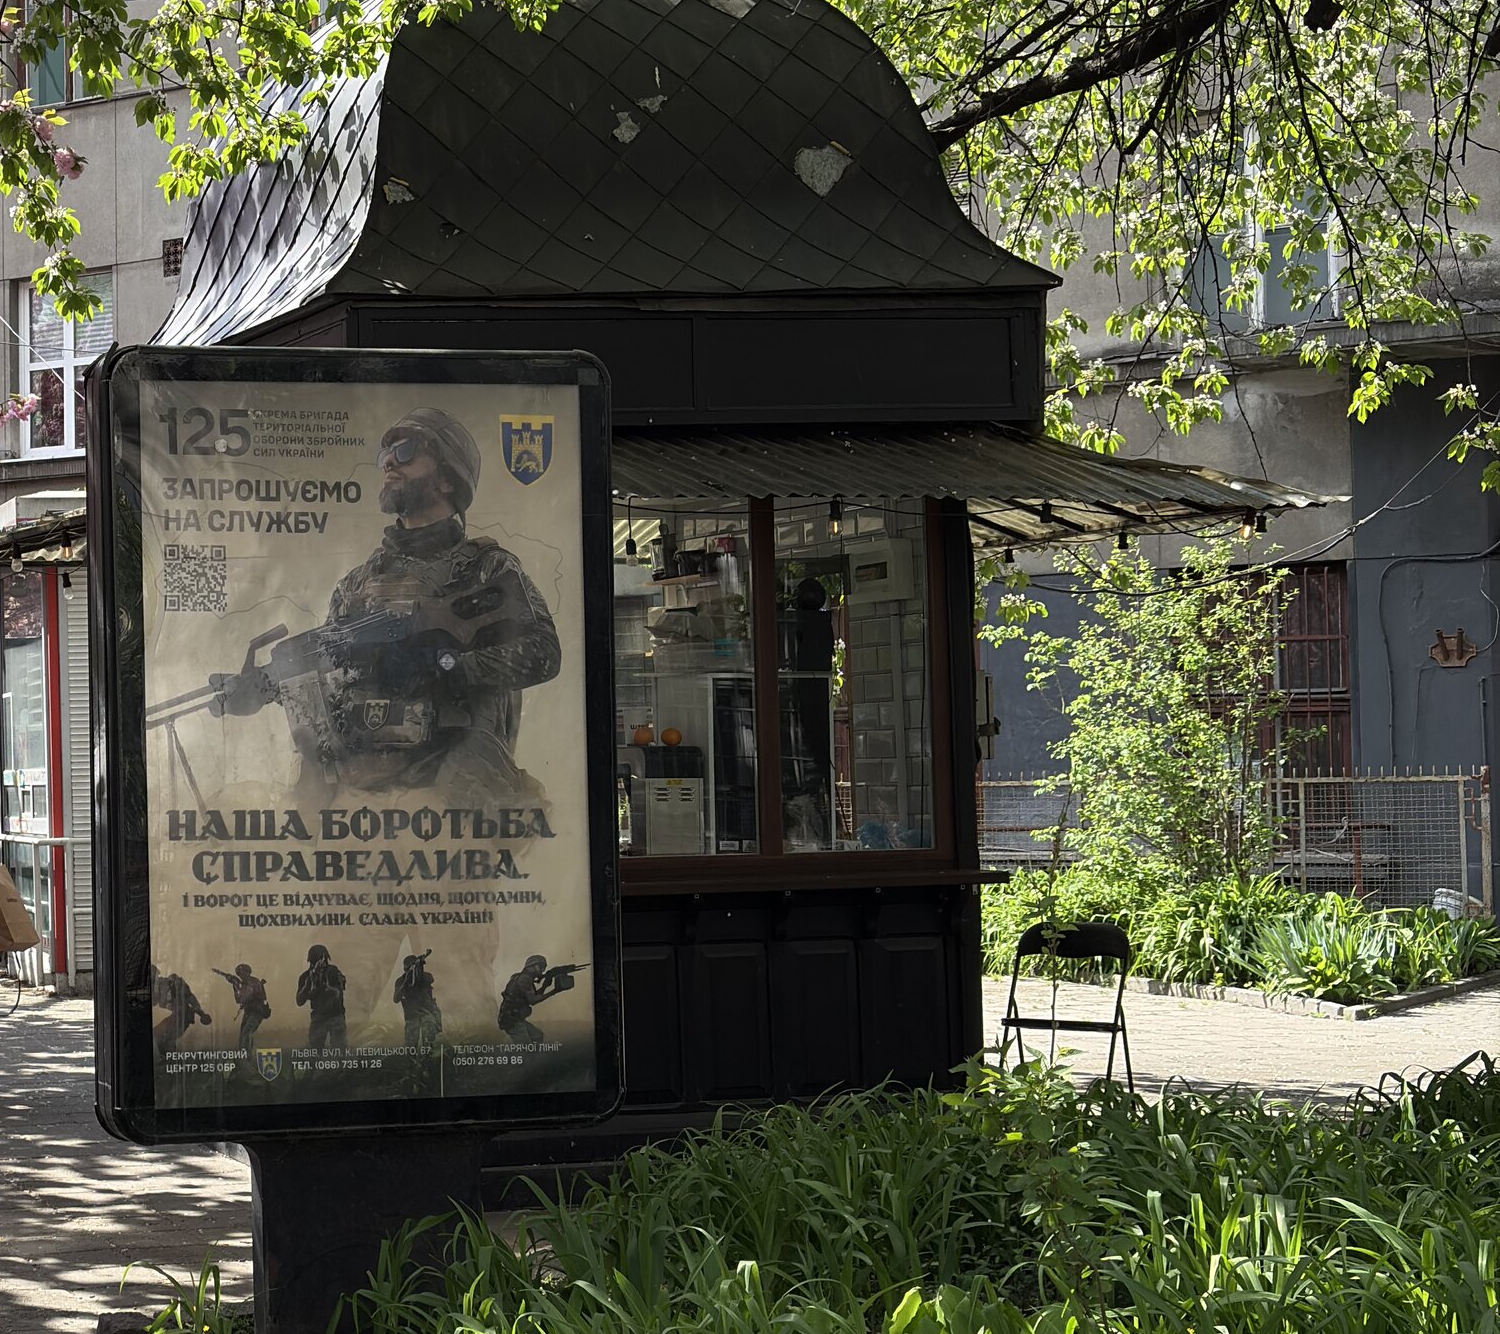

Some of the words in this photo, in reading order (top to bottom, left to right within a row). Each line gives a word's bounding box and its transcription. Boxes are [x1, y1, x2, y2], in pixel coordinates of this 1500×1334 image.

[300, 411, 349, 421] БРИГАДА
[160, 407, 249, 456] 125
[253, 422, 346, 433] ТЕРИТОРІАЛЬНОЇ
[253, 435, 304, 445] ОБОРОНИ
[307, 435, 365, 447] ЗБРОЙНИХ
[253, 448, 276, 457] СИЛ
[279, 447, 325, 458] УКРАЇНИ
[162, 478, 361, 503] ЗАПРОШУЄМО
[164, 509, 201, 532] НА
[208, 510, 329, 534] СЛУЖБУ
[165, 808, 313, 842] НАША
[319, 805, 557, 842] БОРОТЬБА
[192, 848, 530, 885] СПРАВЕДЛИВА.
[193, 893, 252, 908] ВОРОГ
[256, 893, 279, 909] ЦЕ
[282, 891, 373, 908] ВІДЧУВАЄ,
[377, 892, 445, 907] ЩОДНЯ,
[448, 890, 547, 906] ЩОГОДИНИ,
[238, 913, 355, 929] ЩОХВИЛИНИ.
[359, 912, 418, 926] СЛАВА
[165, 1048, 248, 1060] РЕКРУТИНГОВИЙ
[420, 1046, 431, 1055] 67
[452, 1044, 494, 1054] ТЕЛЕФОН
[292, 1061, 312, 1070] ТЕЛ.
[315, 1060, 340, 1070] (066)
[342, 1060, 358, 1069] 735
[360, 1060, 368, 1068] 11
[370, 1059, 382, 1068] 26
[452, 1057, 476, 1066] (050)
[477, 1056, 495, 1065] 276
[496, 1056, 509, 1065] 69
[510, 1055, 523, 1064] 86
[166, 1064, 198, 1074] ЦЕНТР
[200, 1063, 215, 1073] 125
[217, 1063, 236, 1072] ОБР
